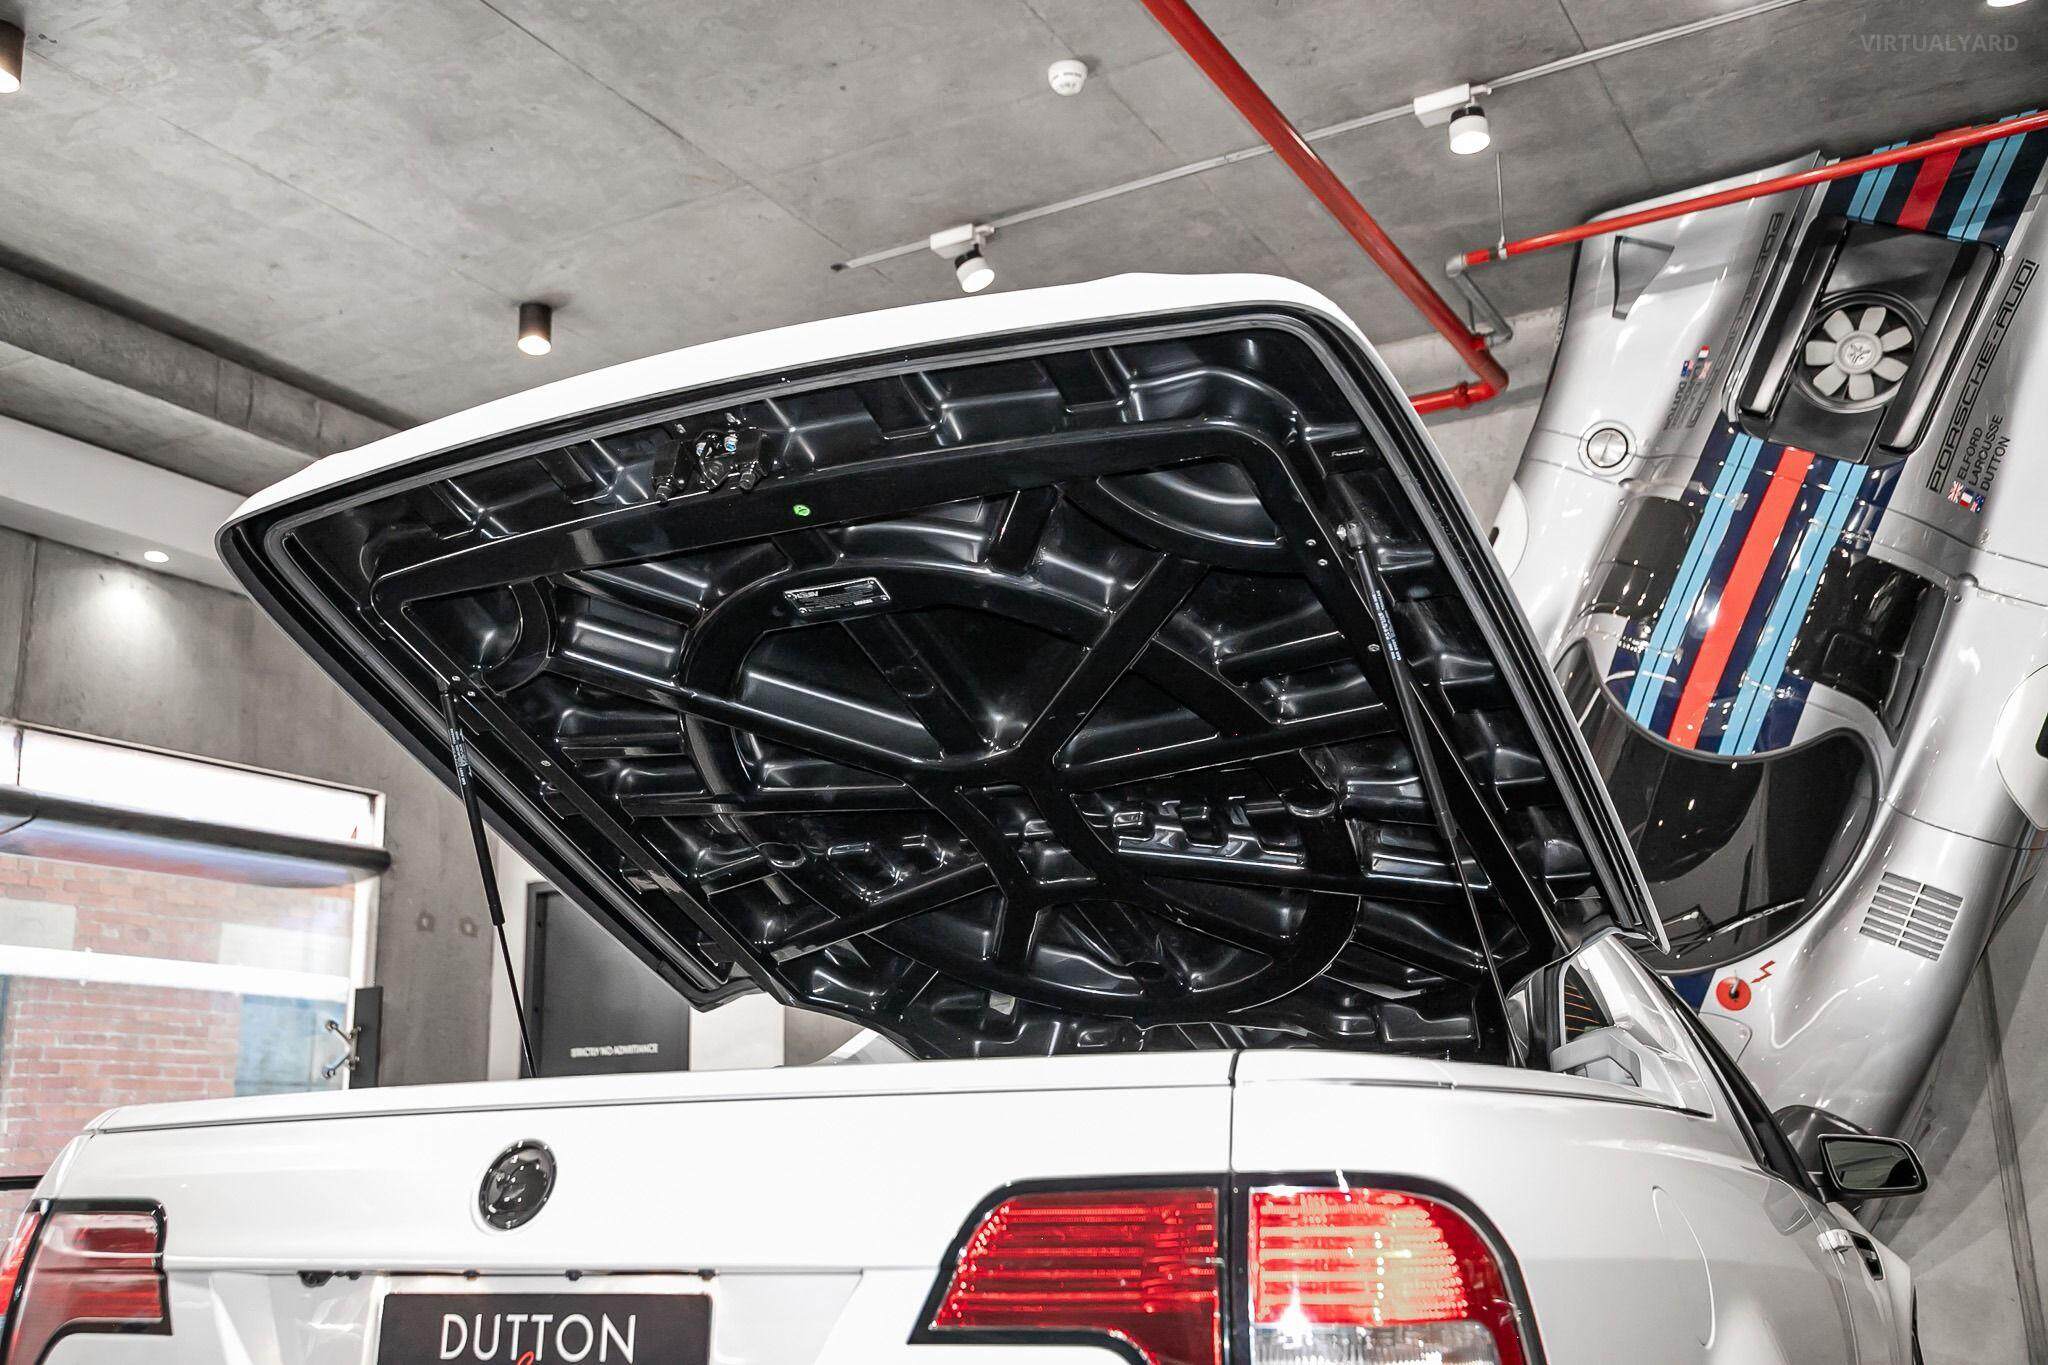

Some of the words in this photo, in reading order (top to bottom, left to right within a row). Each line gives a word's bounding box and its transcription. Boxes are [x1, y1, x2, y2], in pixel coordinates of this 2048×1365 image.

[1927, 258, 2039, 493] PORSCHE-AUDI
[1957, 427, 1983, 481] ELFORD
[1969, 414, 2004, 487] LAROUSSE
[1980, 436, 2011, 492] DUTTON
[439, 1313, 637, 1363] DUTTON
